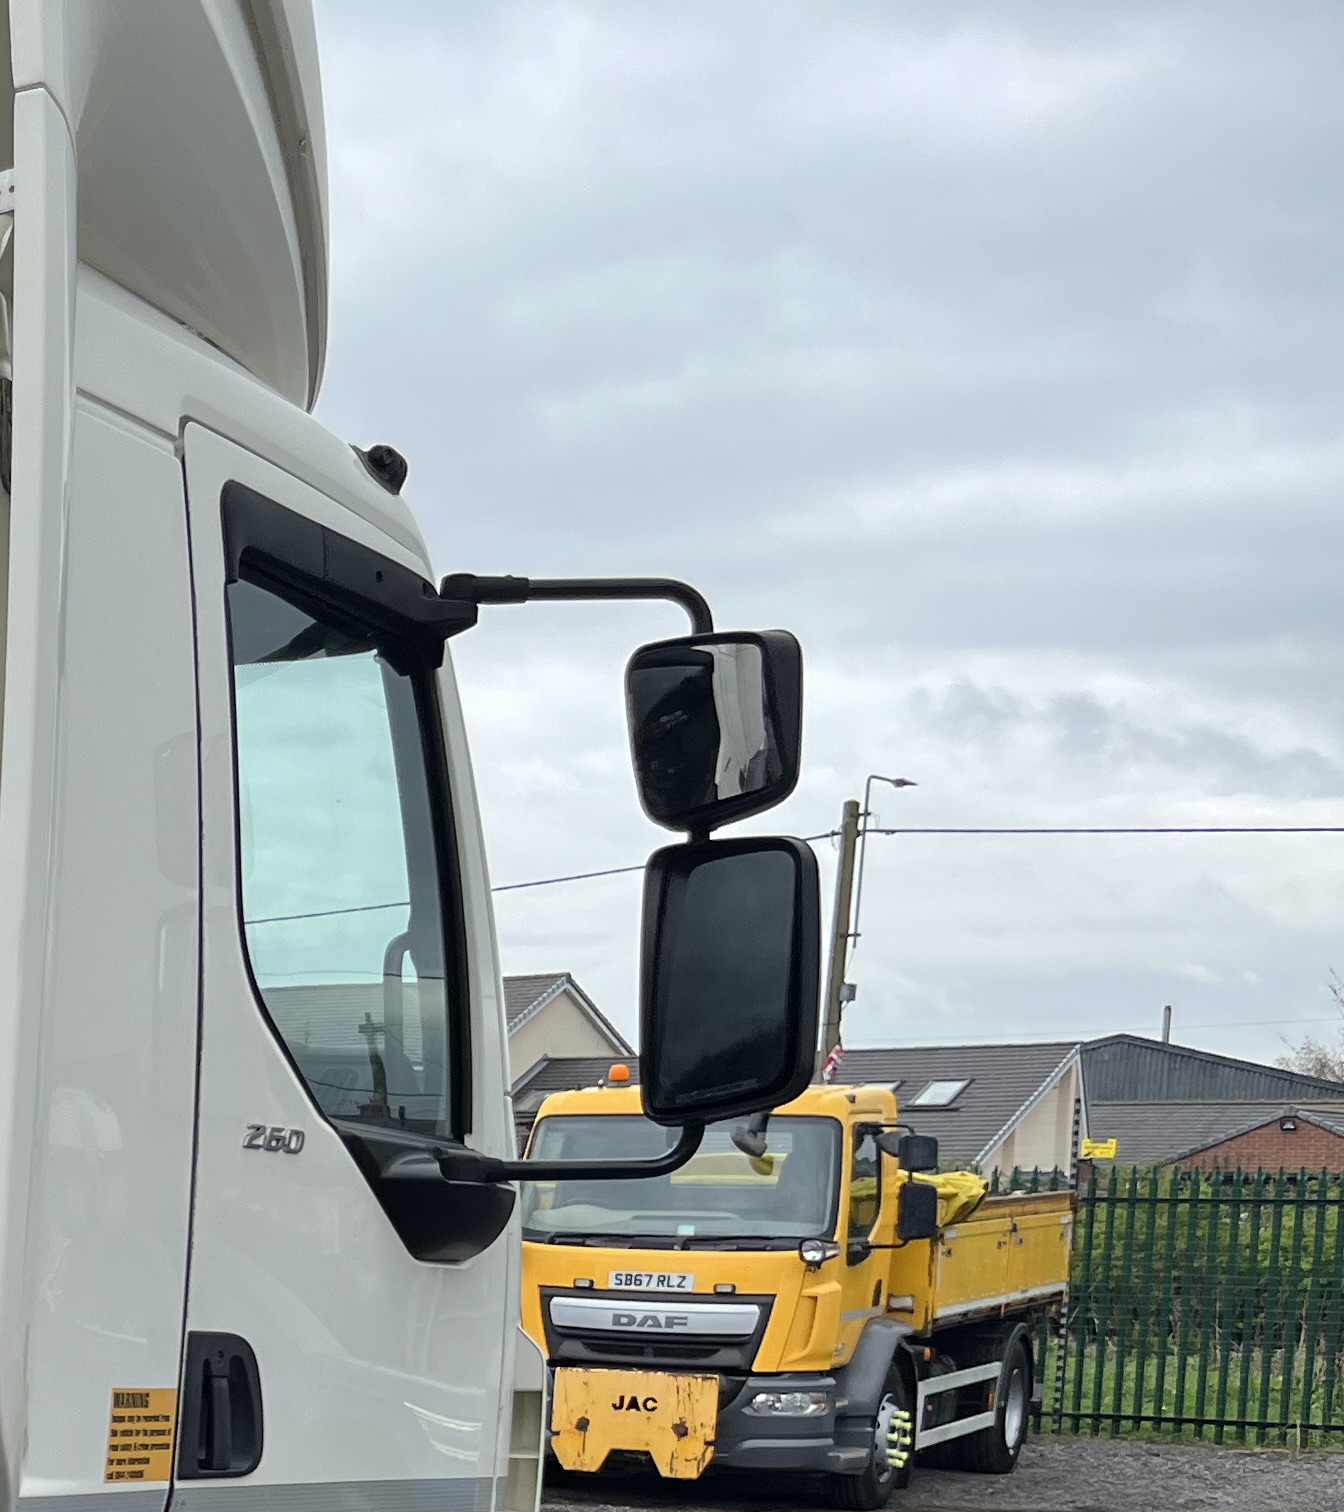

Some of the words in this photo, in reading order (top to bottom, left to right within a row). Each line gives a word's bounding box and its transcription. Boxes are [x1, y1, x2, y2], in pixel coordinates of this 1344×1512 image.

[242, 1123, 305, 1154] 260
[614, 1273, 653, 1287] SB67
[656, 1274, 687, 1289] RLZ
[612, 1313, 688, 1329] DAF
[611, 1395, 658, 1412] JAC
